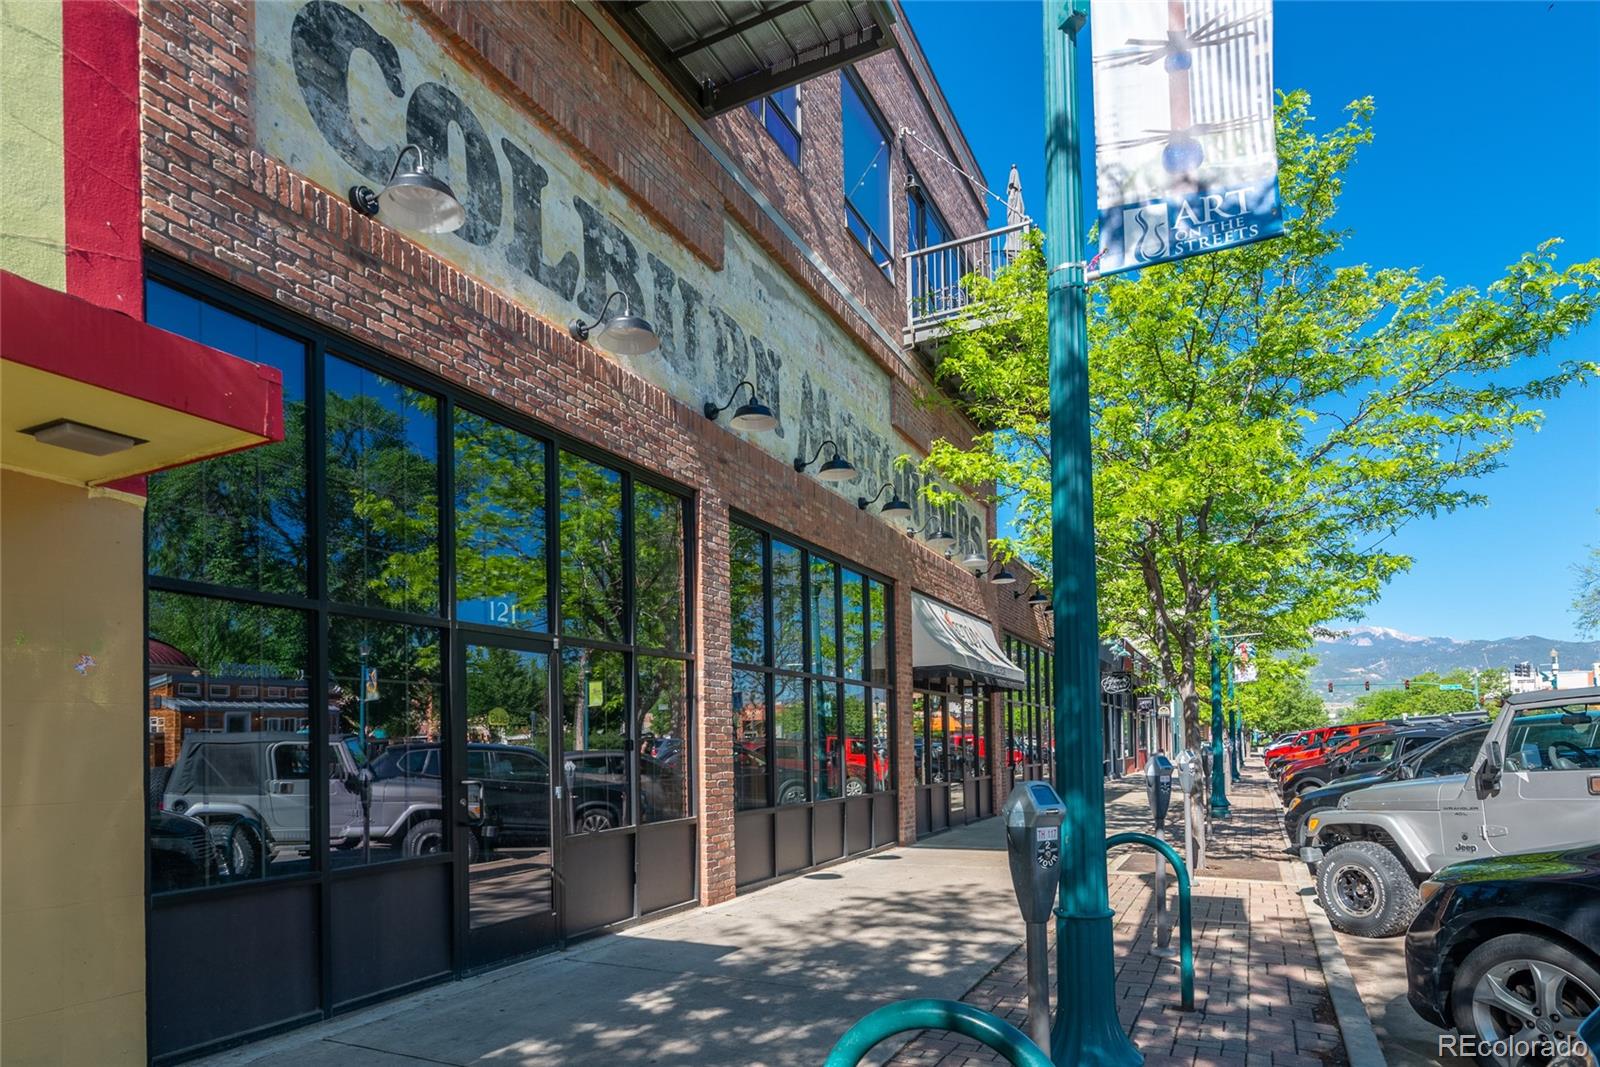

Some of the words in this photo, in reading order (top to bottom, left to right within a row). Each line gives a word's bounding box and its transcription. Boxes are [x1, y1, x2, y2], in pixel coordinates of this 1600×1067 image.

[1171, 187, 1255, 230] ART
[1174, 226, 1201, 241] ON
[1210, 216, 1246, 233] THE
[1174, 224, 1259, 255] STREETS
[490, 601, 516, 624] 121
[1045, 841, 1051, 850] 2
[1455, 843, 1478, 852] Jeep
[1037, 854, 1058, 867] HOUR
